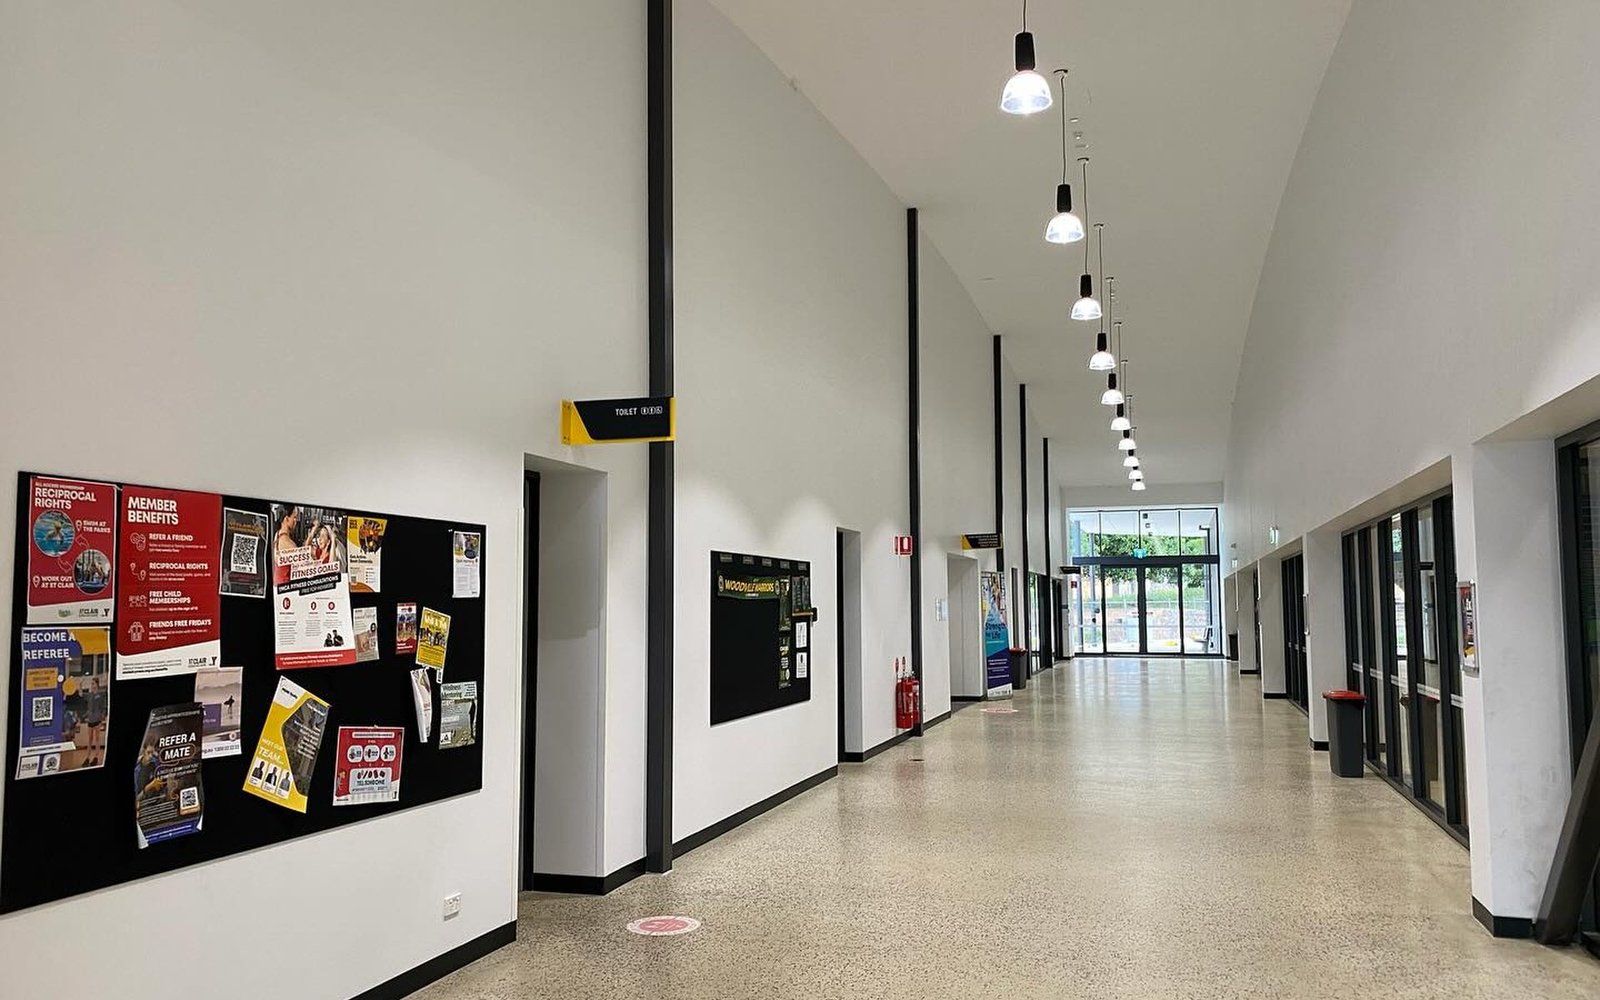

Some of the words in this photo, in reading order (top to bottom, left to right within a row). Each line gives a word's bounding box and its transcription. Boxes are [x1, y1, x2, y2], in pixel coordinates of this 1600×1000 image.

[615, 408, 637, 416] TOILET
[35, 487, 97, 502] RECIPROCAL
[35, 498, 72, 510] RIGHTS
[128, 496, 177, 512] MEMBER
[128, 510, 179, 525] BENEFITS
[279, 552, 310, 564] SUCCESS
[149, 562, 185, 570] RECIPROCAL
[291, 567, 317, 579] FITNESS
[317, 563, 339, 574] GOALS
[291, 581, 307, 589] FITNESS
[188, 619, 211, 627] FRIDAYS
[23, 632, 66, 643] BECOME
[68, 632, 76, 641] A
[23, 649, 70, 660] REFEREE
[159, 733, 188, 748] REFER
[188, 732, 196, 743] A
[164, 746, 191, 761] MATE
